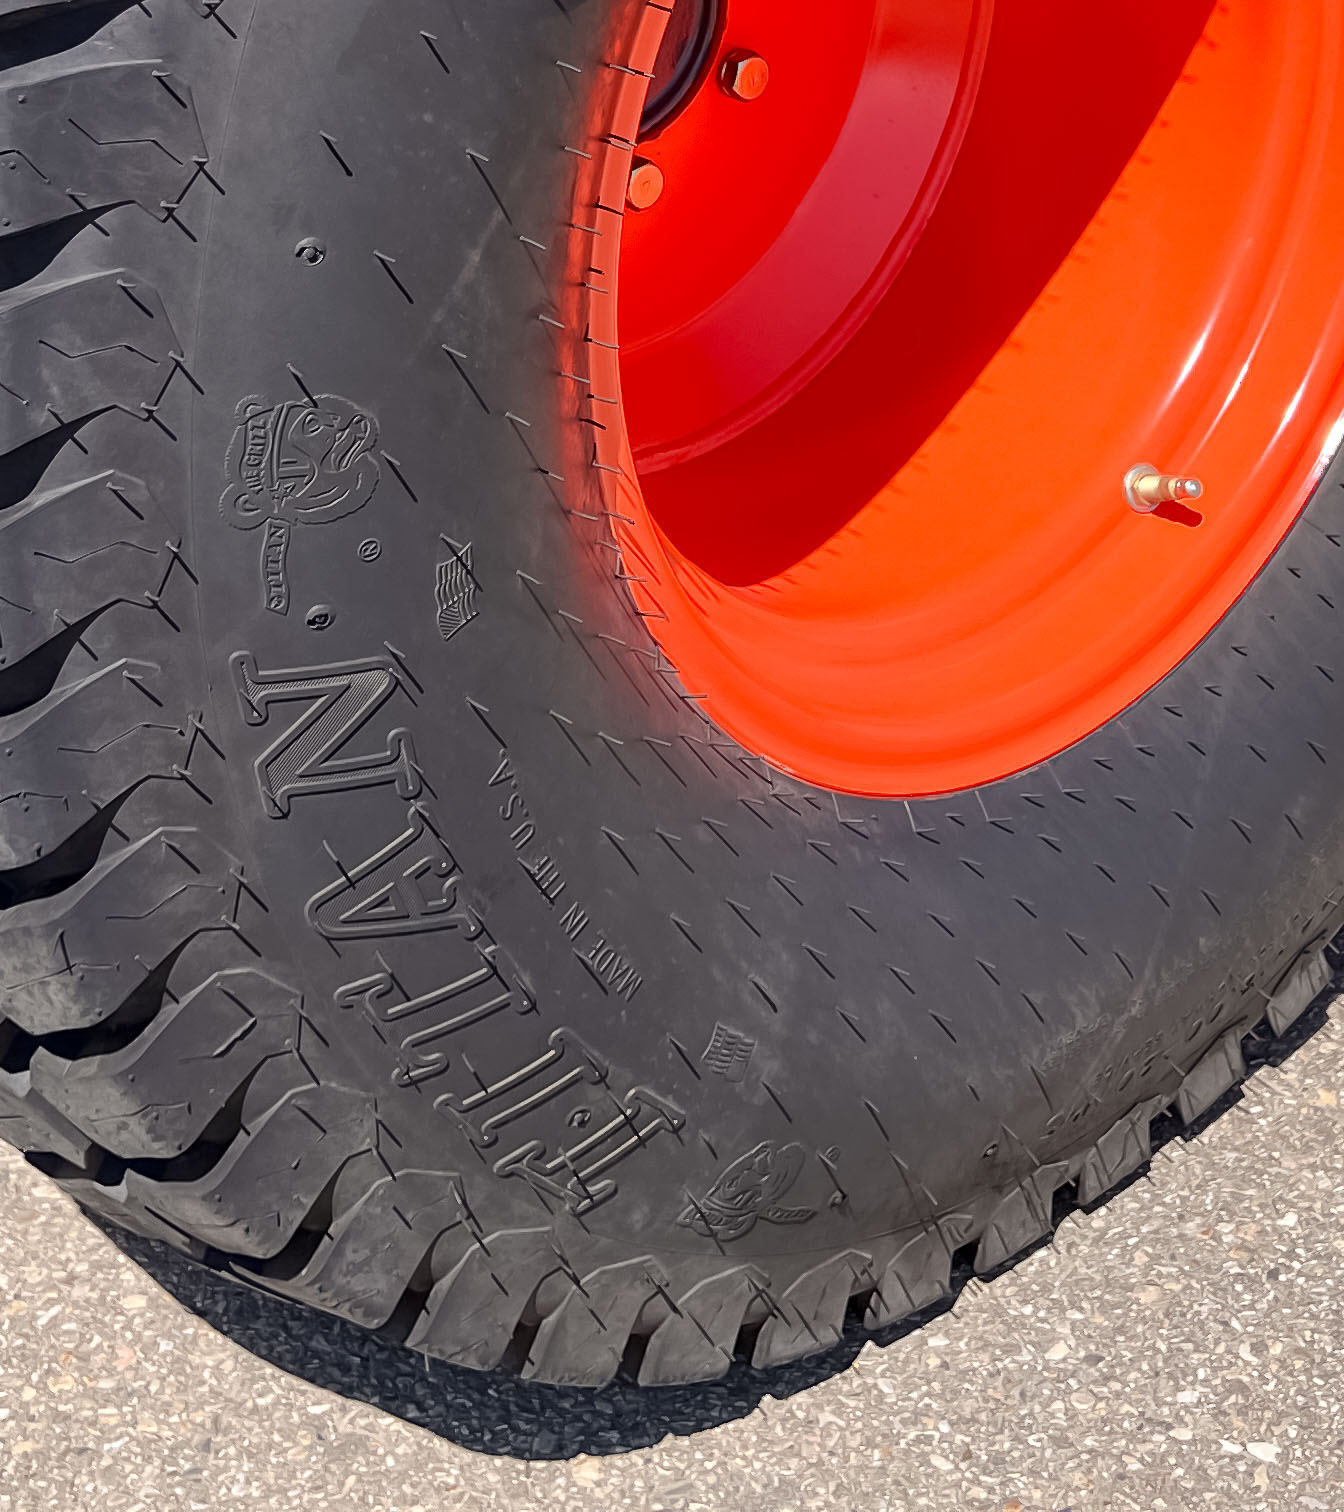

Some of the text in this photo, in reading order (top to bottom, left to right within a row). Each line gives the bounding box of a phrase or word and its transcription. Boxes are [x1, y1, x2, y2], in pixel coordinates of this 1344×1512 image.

[488, 749, 535, 850] U.S.A.
[228, 651, 687, 1217] TITAN
[560, 901, 589, 941] IN
[589, 939, 643, 1002] MADE
